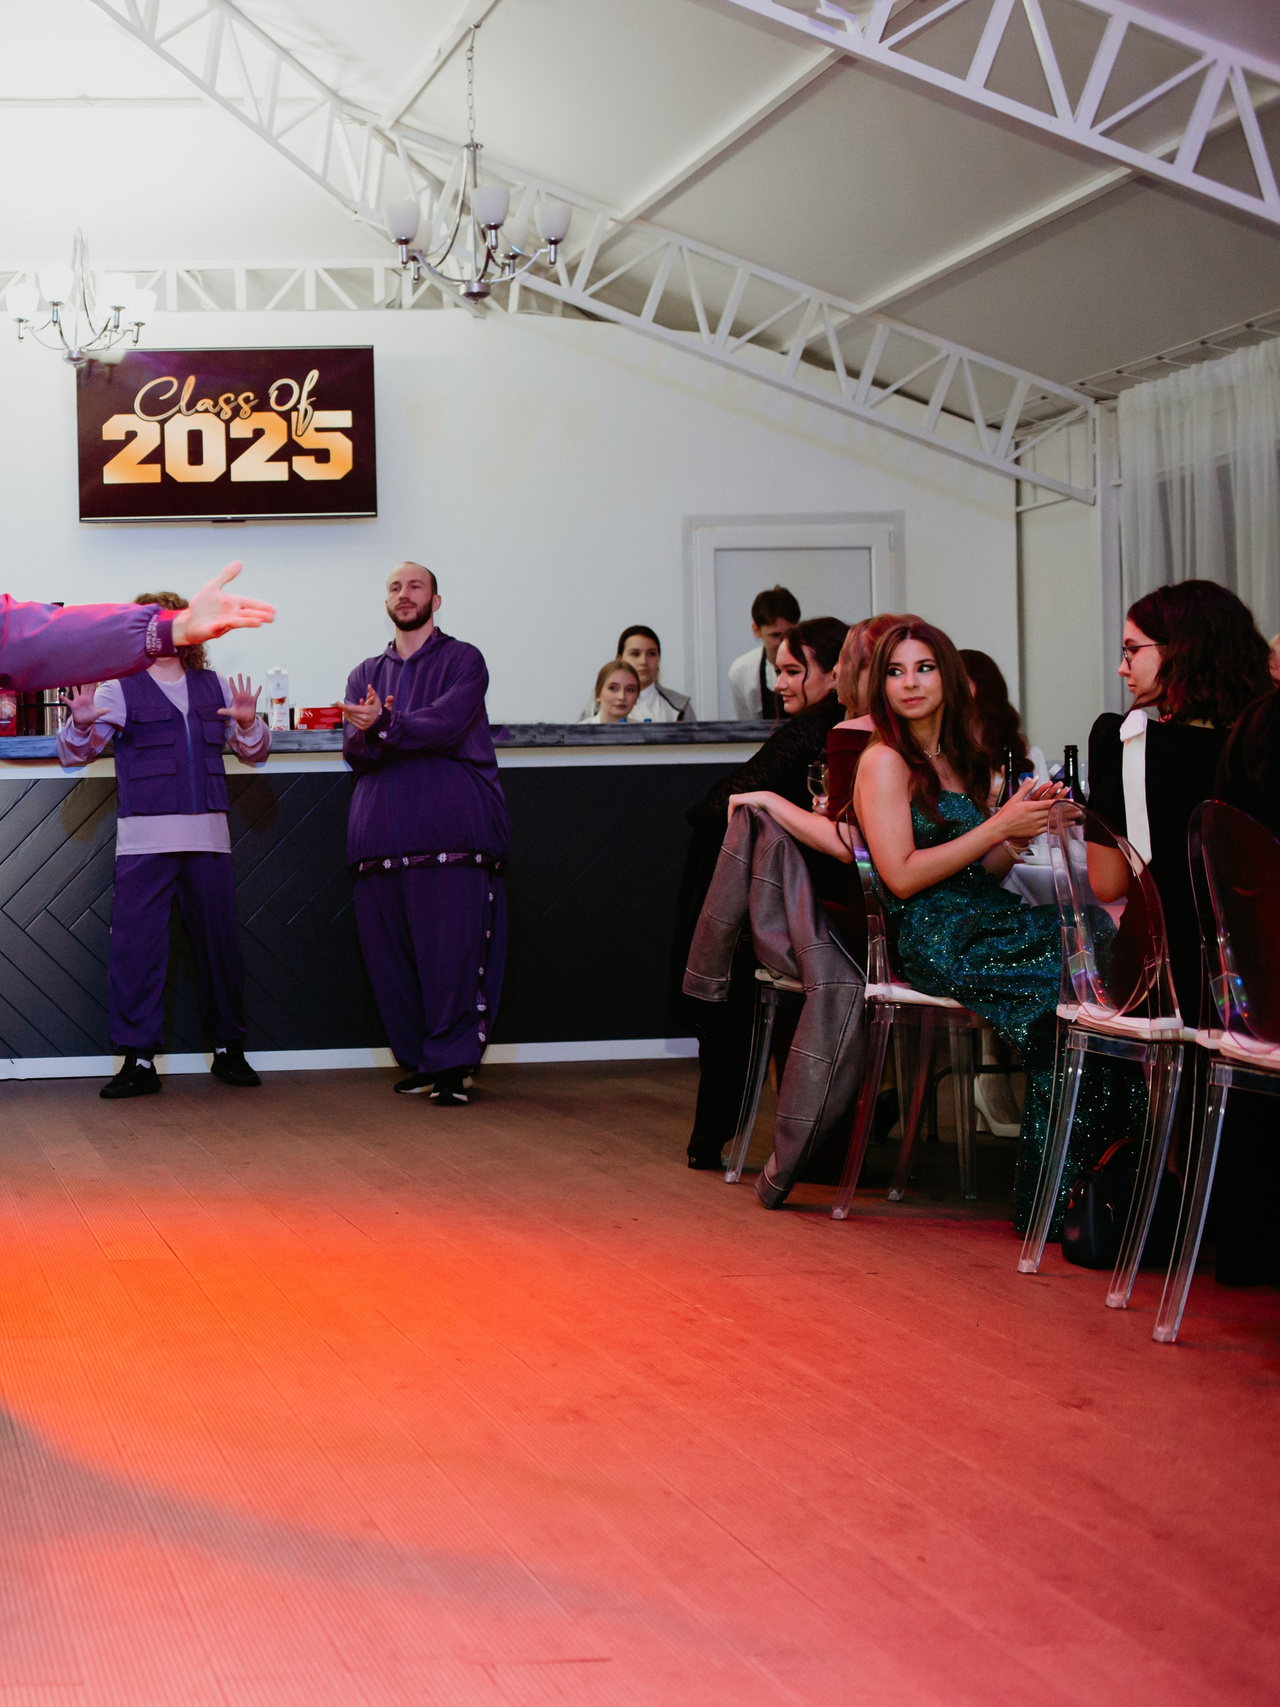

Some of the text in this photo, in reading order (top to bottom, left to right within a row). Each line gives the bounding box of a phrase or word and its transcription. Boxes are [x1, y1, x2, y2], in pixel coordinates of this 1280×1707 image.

[134, 369, 319, 436] Class Of
[102, 410, 353, 484] 2025
